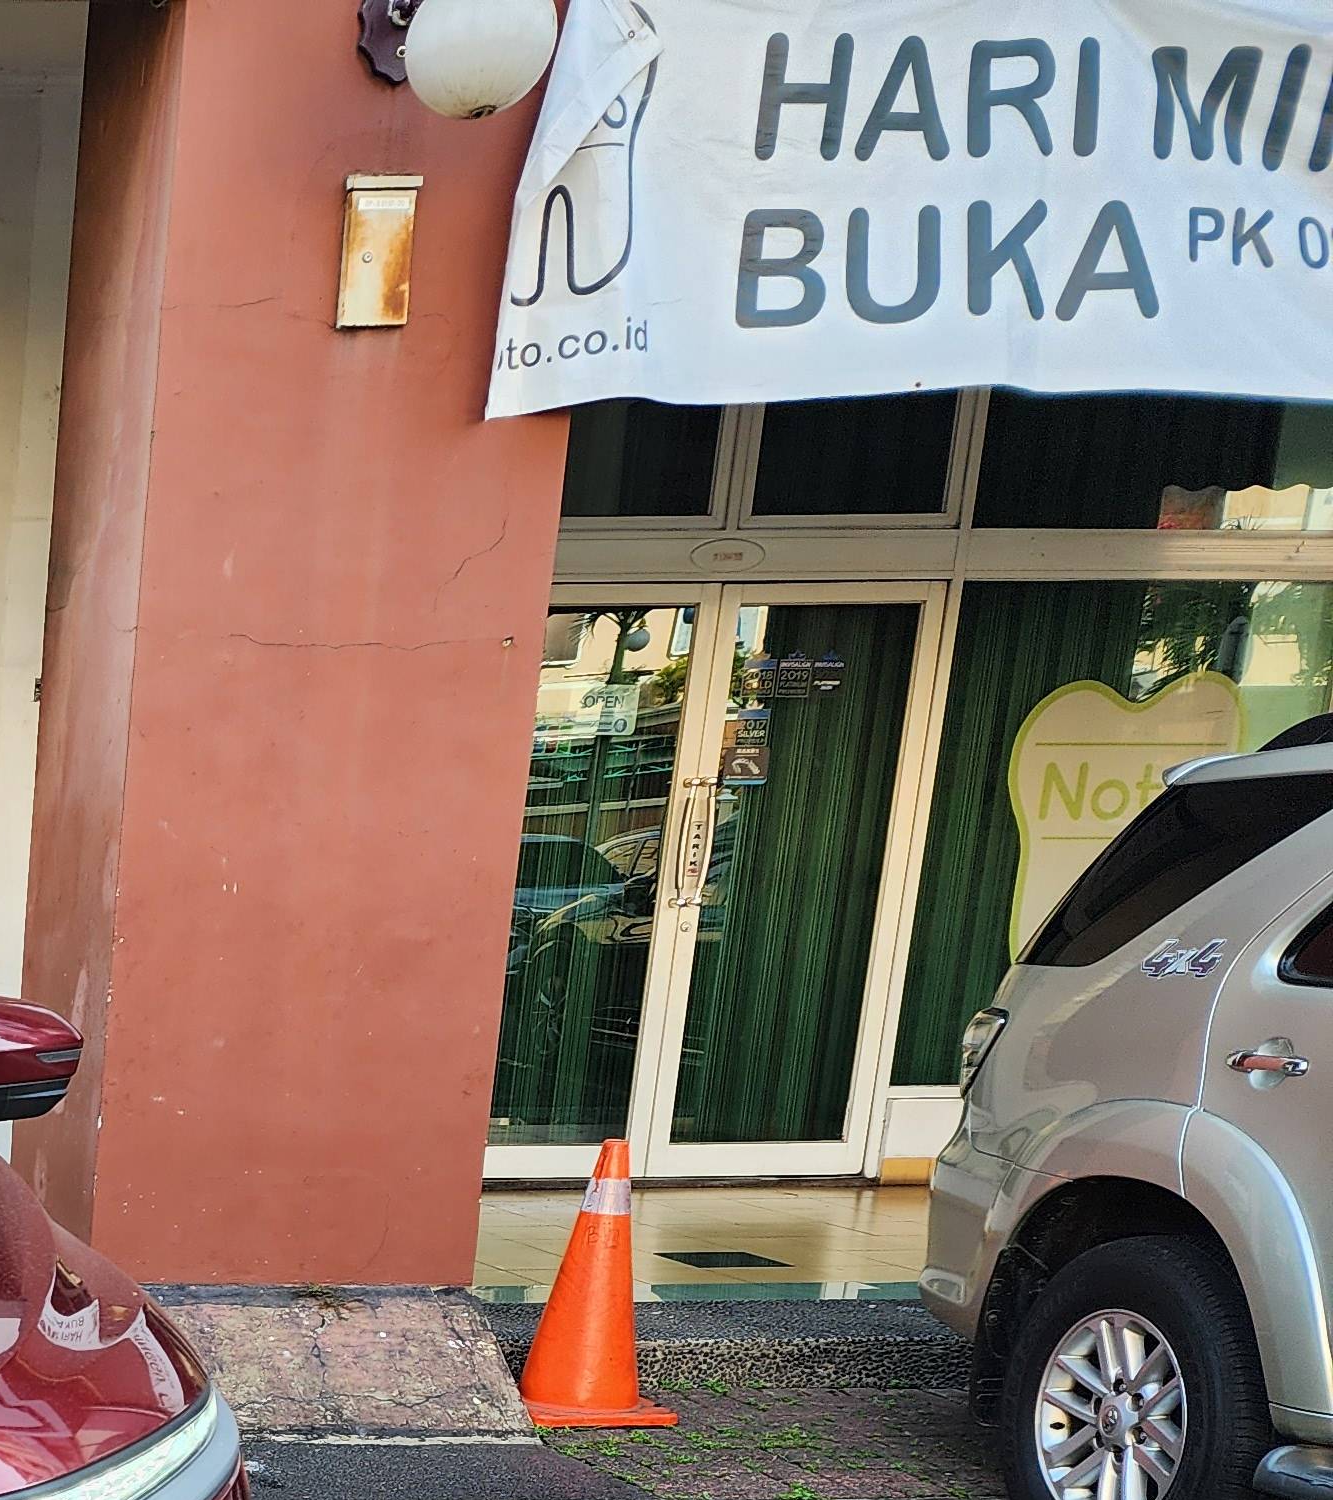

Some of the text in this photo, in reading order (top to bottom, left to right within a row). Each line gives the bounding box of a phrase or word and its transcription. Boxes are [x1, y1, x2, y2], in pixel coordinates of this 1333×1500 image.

[754, 32, 1100, 161] HARI
[735, 199, 1333, 329] BUKA PK 0
[497, 316, 648, 371] to.co.id
[743, 669, 774, 681] 2018
[780, 670, 809, 681] 2019
[743, 680, 772, 690] GOLD
[584, 695, 625, 709] OPEN
[737, 720, 767, 730] 2017
[737, 730, 765, 738] SILVER
[689, 823, 703, 867] TARIK
[1141, 938, 1227, 979] 4x4
